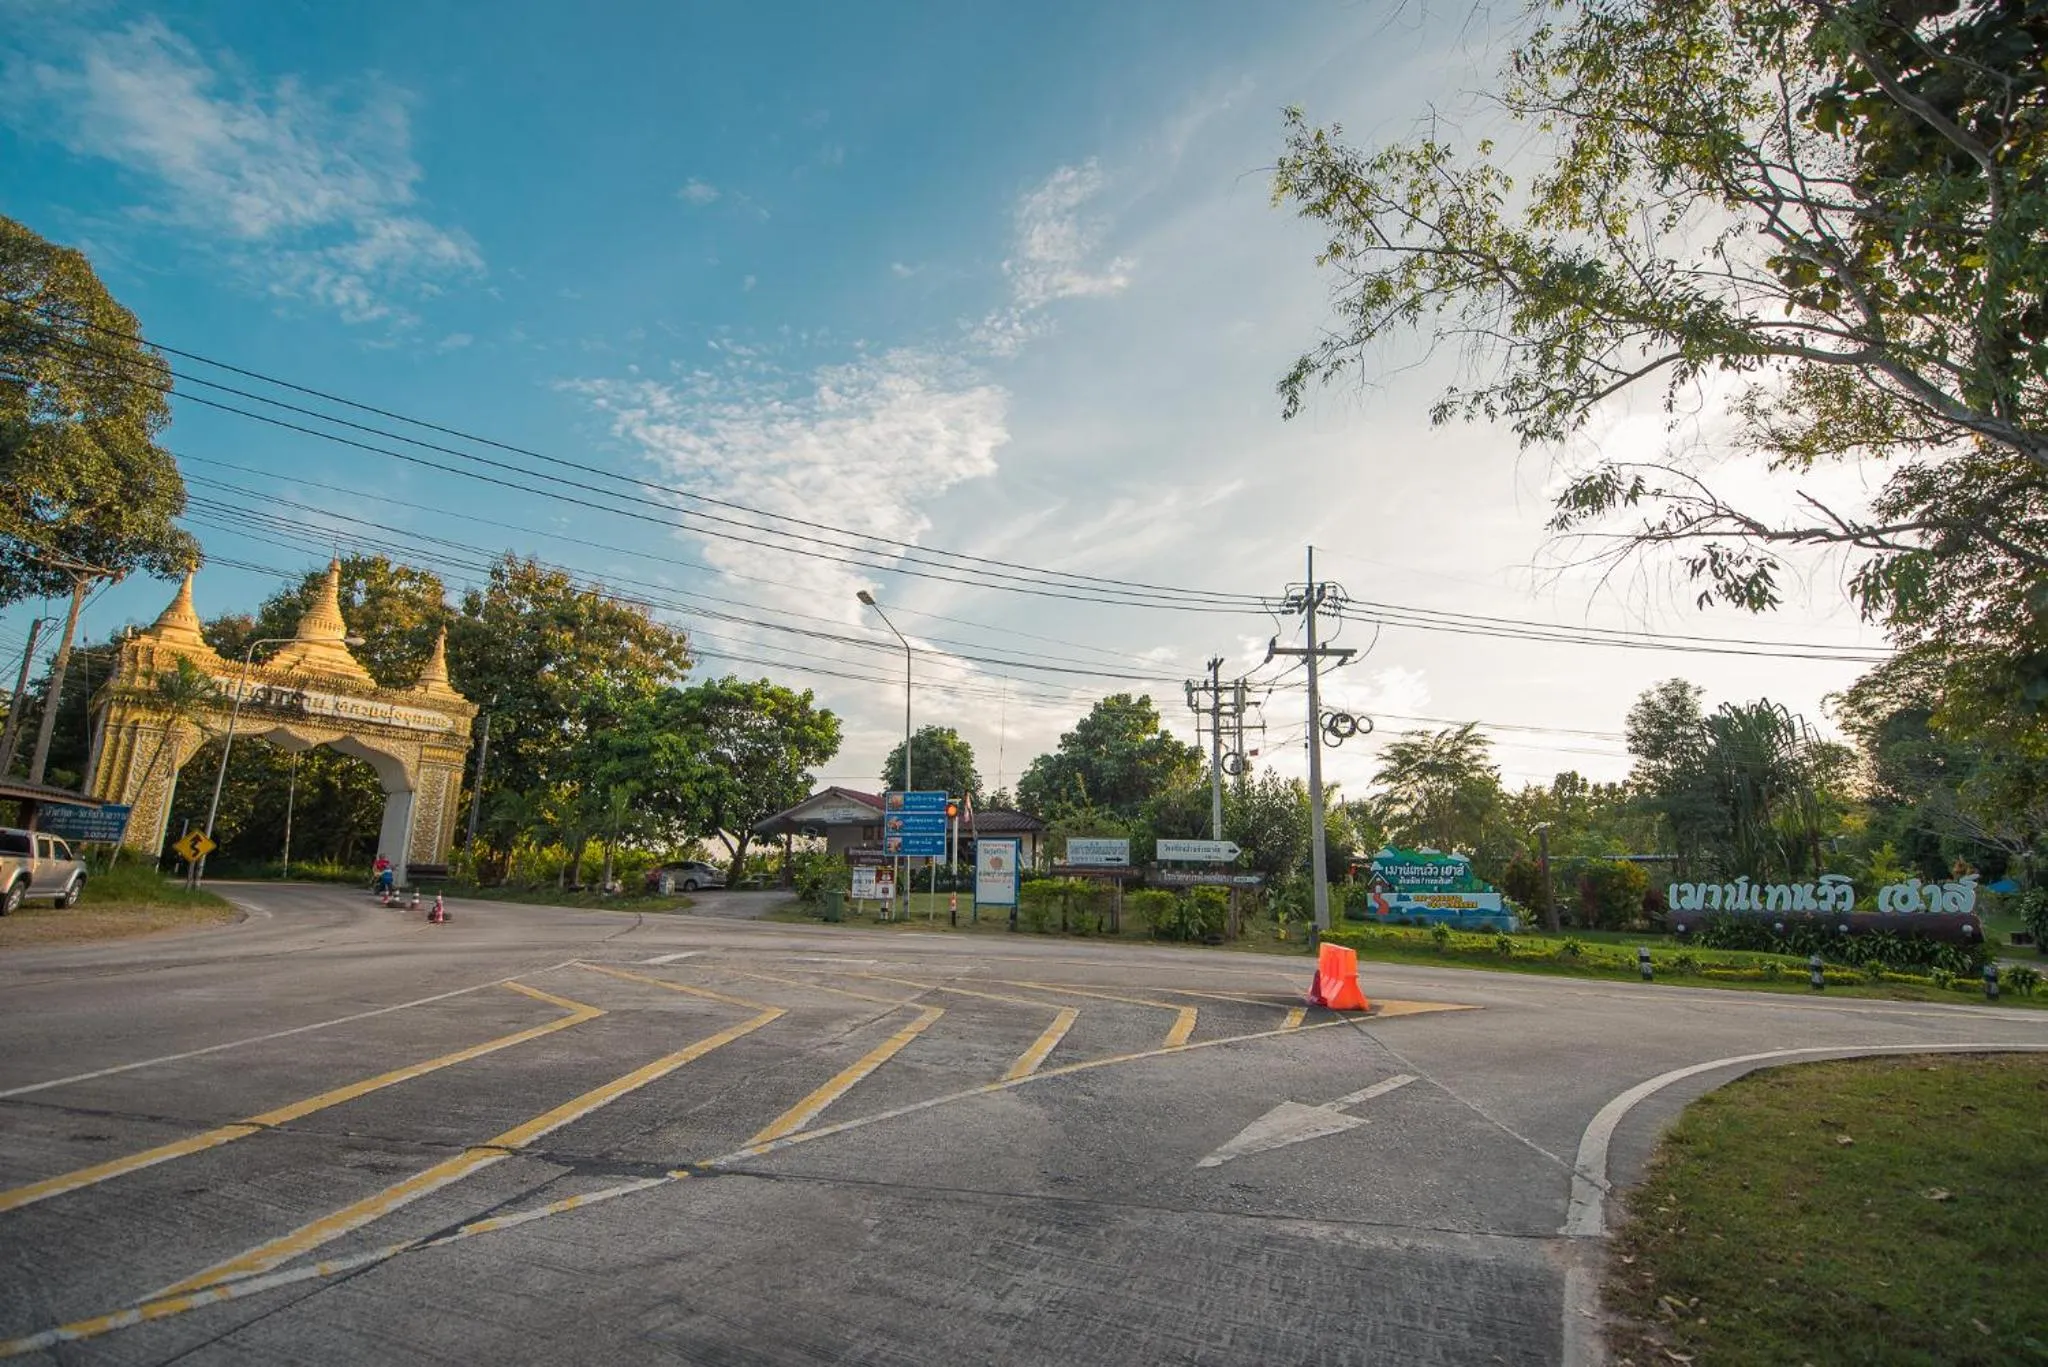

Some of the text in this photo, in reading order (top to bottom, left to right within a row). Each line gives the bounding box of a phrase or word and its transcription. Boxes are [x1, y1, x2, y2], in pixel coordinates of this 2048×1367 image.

[1668, 874, 1980, 913] เมาน์เทนวิว เฮาส์
